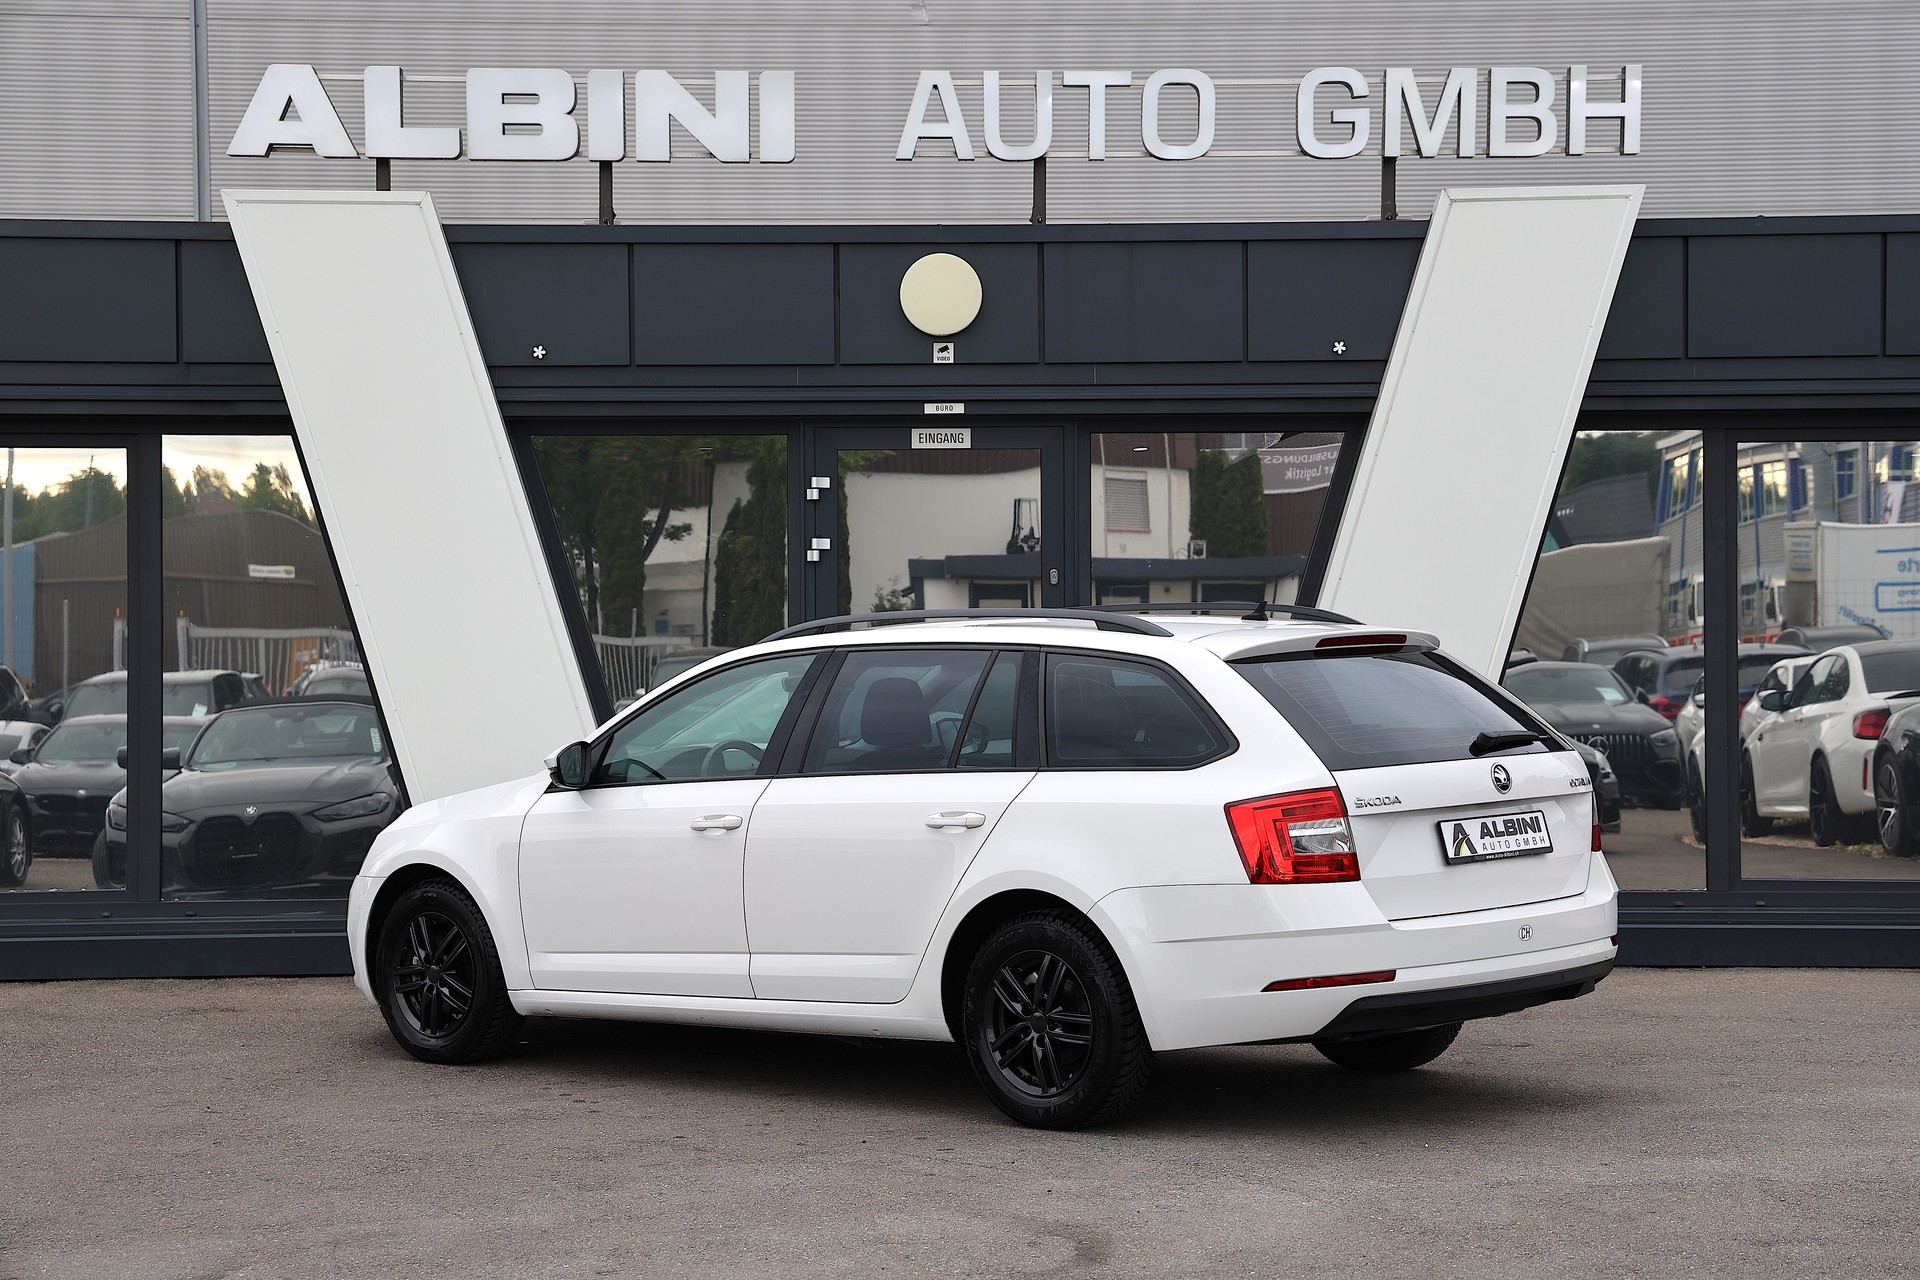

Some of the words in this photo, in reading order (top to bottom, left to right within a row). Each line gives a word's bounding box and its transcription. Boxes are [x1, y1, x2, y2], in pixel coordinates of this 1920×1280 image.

[226, 63, 796, 163] ALBINI
[896, 68, 1216, 161] AUTO
[1297, 64, 1642, 159] GMBH
[935, 403, 954, 412] BÜRO
[918, 432, 965, 444] EINGANG
[1354, 796, 1402, 809] ŠKODA
[1480, 815, 1542, 839] ALBINI
[1482, 839, 1511, 852] AUTO
[1515, 836, 1546, 848] GMBH
[1521, 927, 1531, 939] CH
